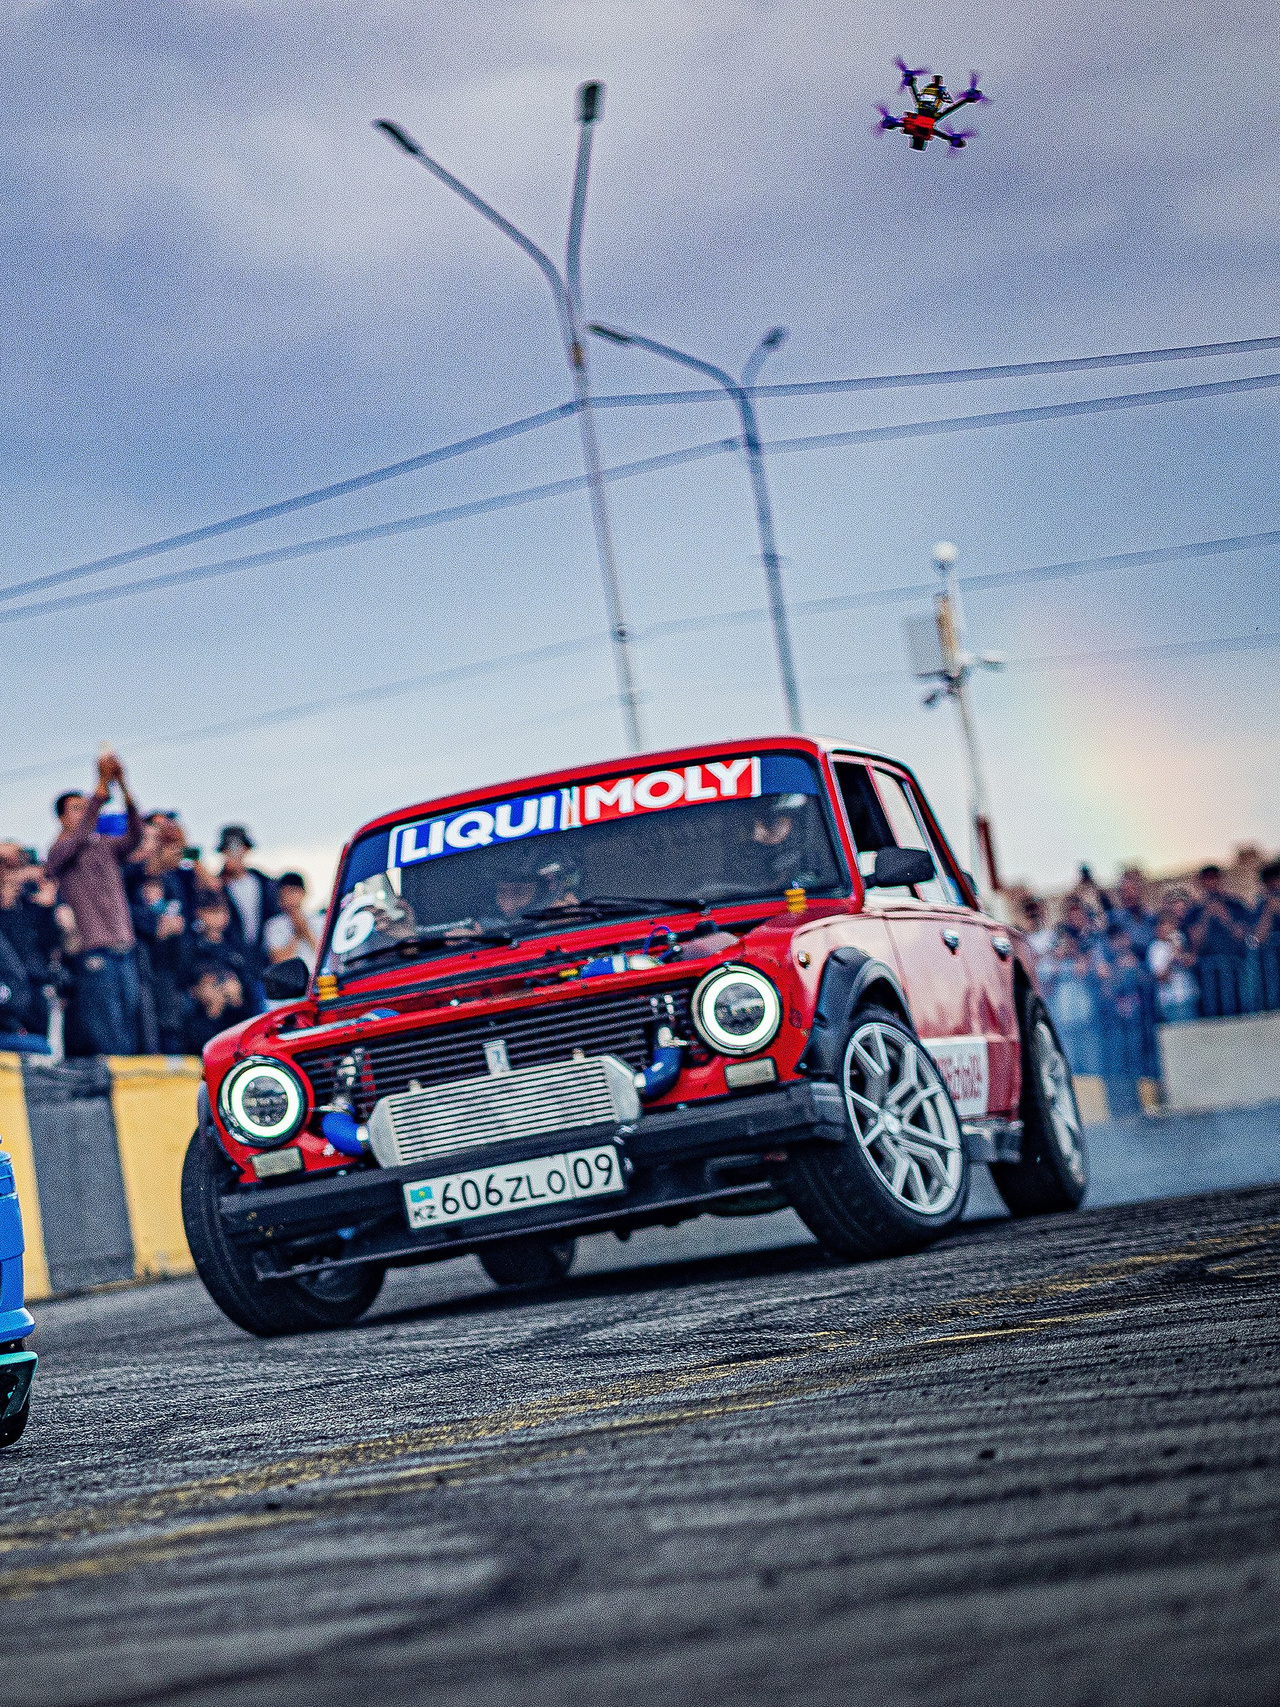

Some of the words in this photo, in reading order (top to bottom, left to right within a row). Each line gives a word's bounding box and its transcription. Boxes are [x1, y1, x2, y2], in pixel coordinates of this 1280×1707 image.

[400, 795, 557, 864] LIQUI
[584, 757, 752, 821] MOLY
[331, 893, 375, 954] 6
[412, 1204, 438, 1222] KZ
